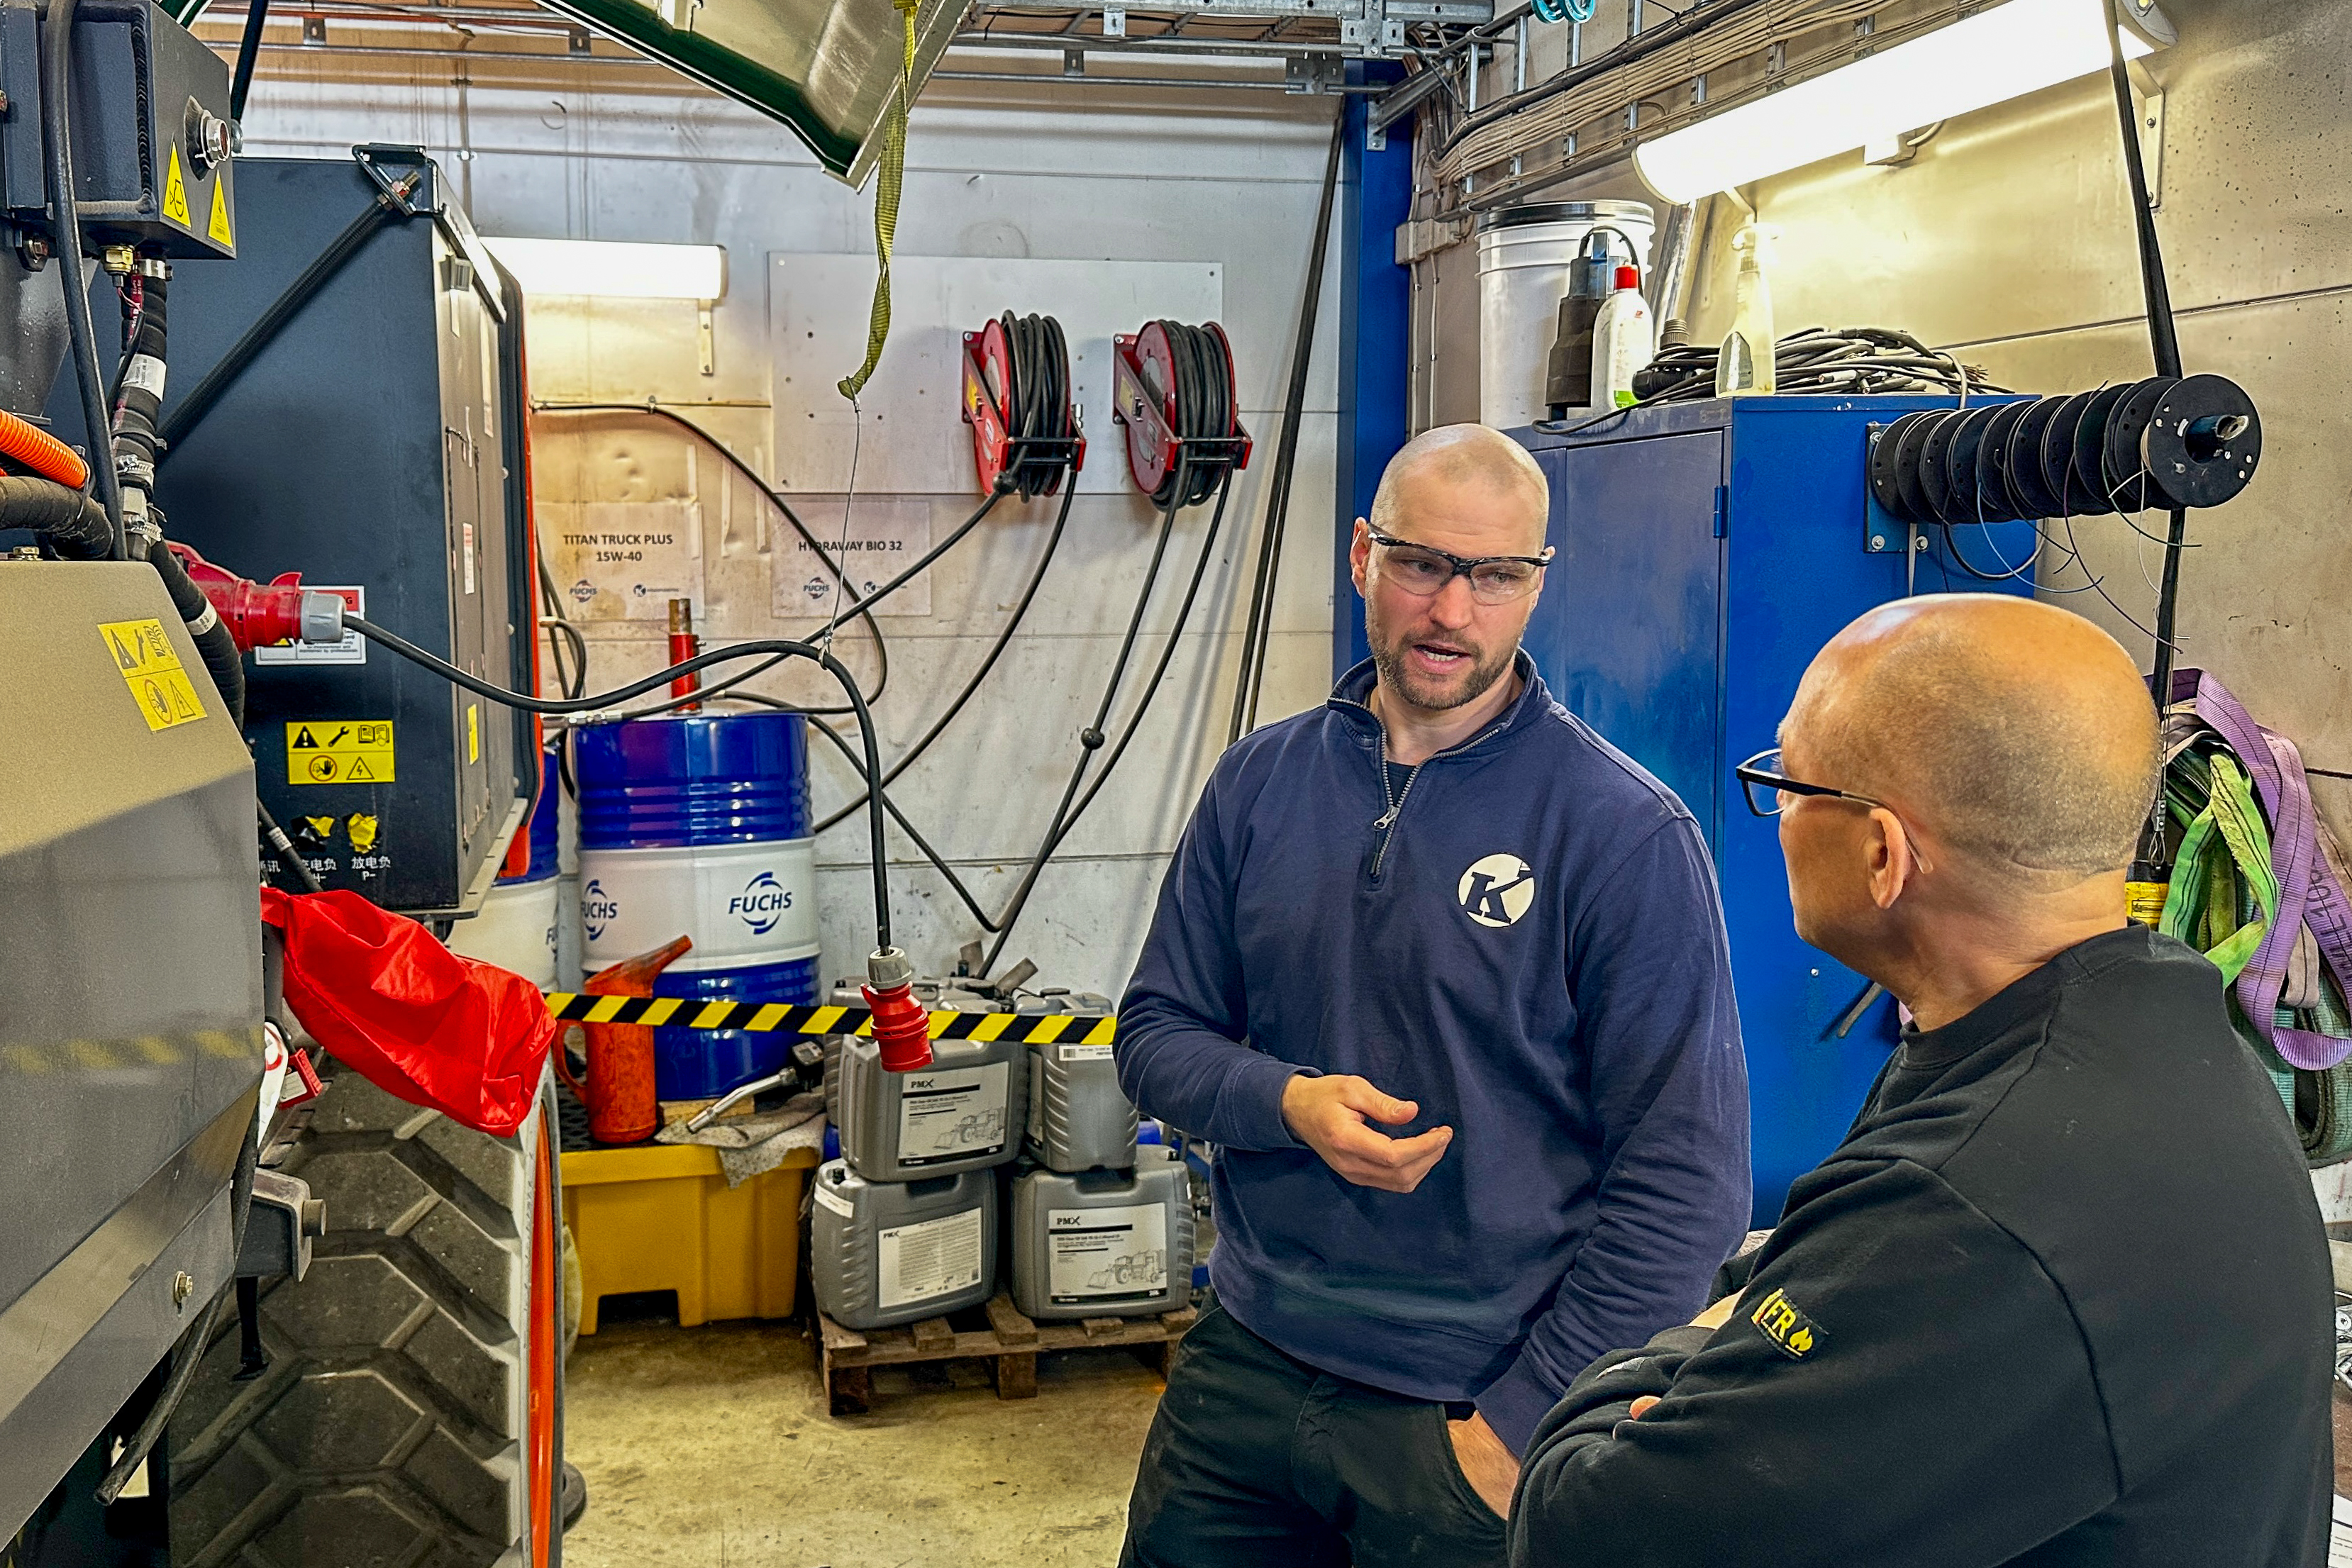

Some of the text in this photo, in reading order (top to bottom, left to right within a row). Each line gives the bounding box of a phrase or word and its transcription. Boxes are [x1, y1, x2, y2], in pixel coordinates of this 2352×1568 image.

[563, 534, 673, 545] TITAN TRUCK PLUS
[799, 541, 902, 551] HDRAWAY BIO 32
[597, 551, 643, 562] 15W-40
[351, 855, 391, 869] 放电负
[728, 891, 792, 914] FUCHS
[911, 1079, 934, 1089] PMX
[1057, 1216, 1081, 1225] PMX
